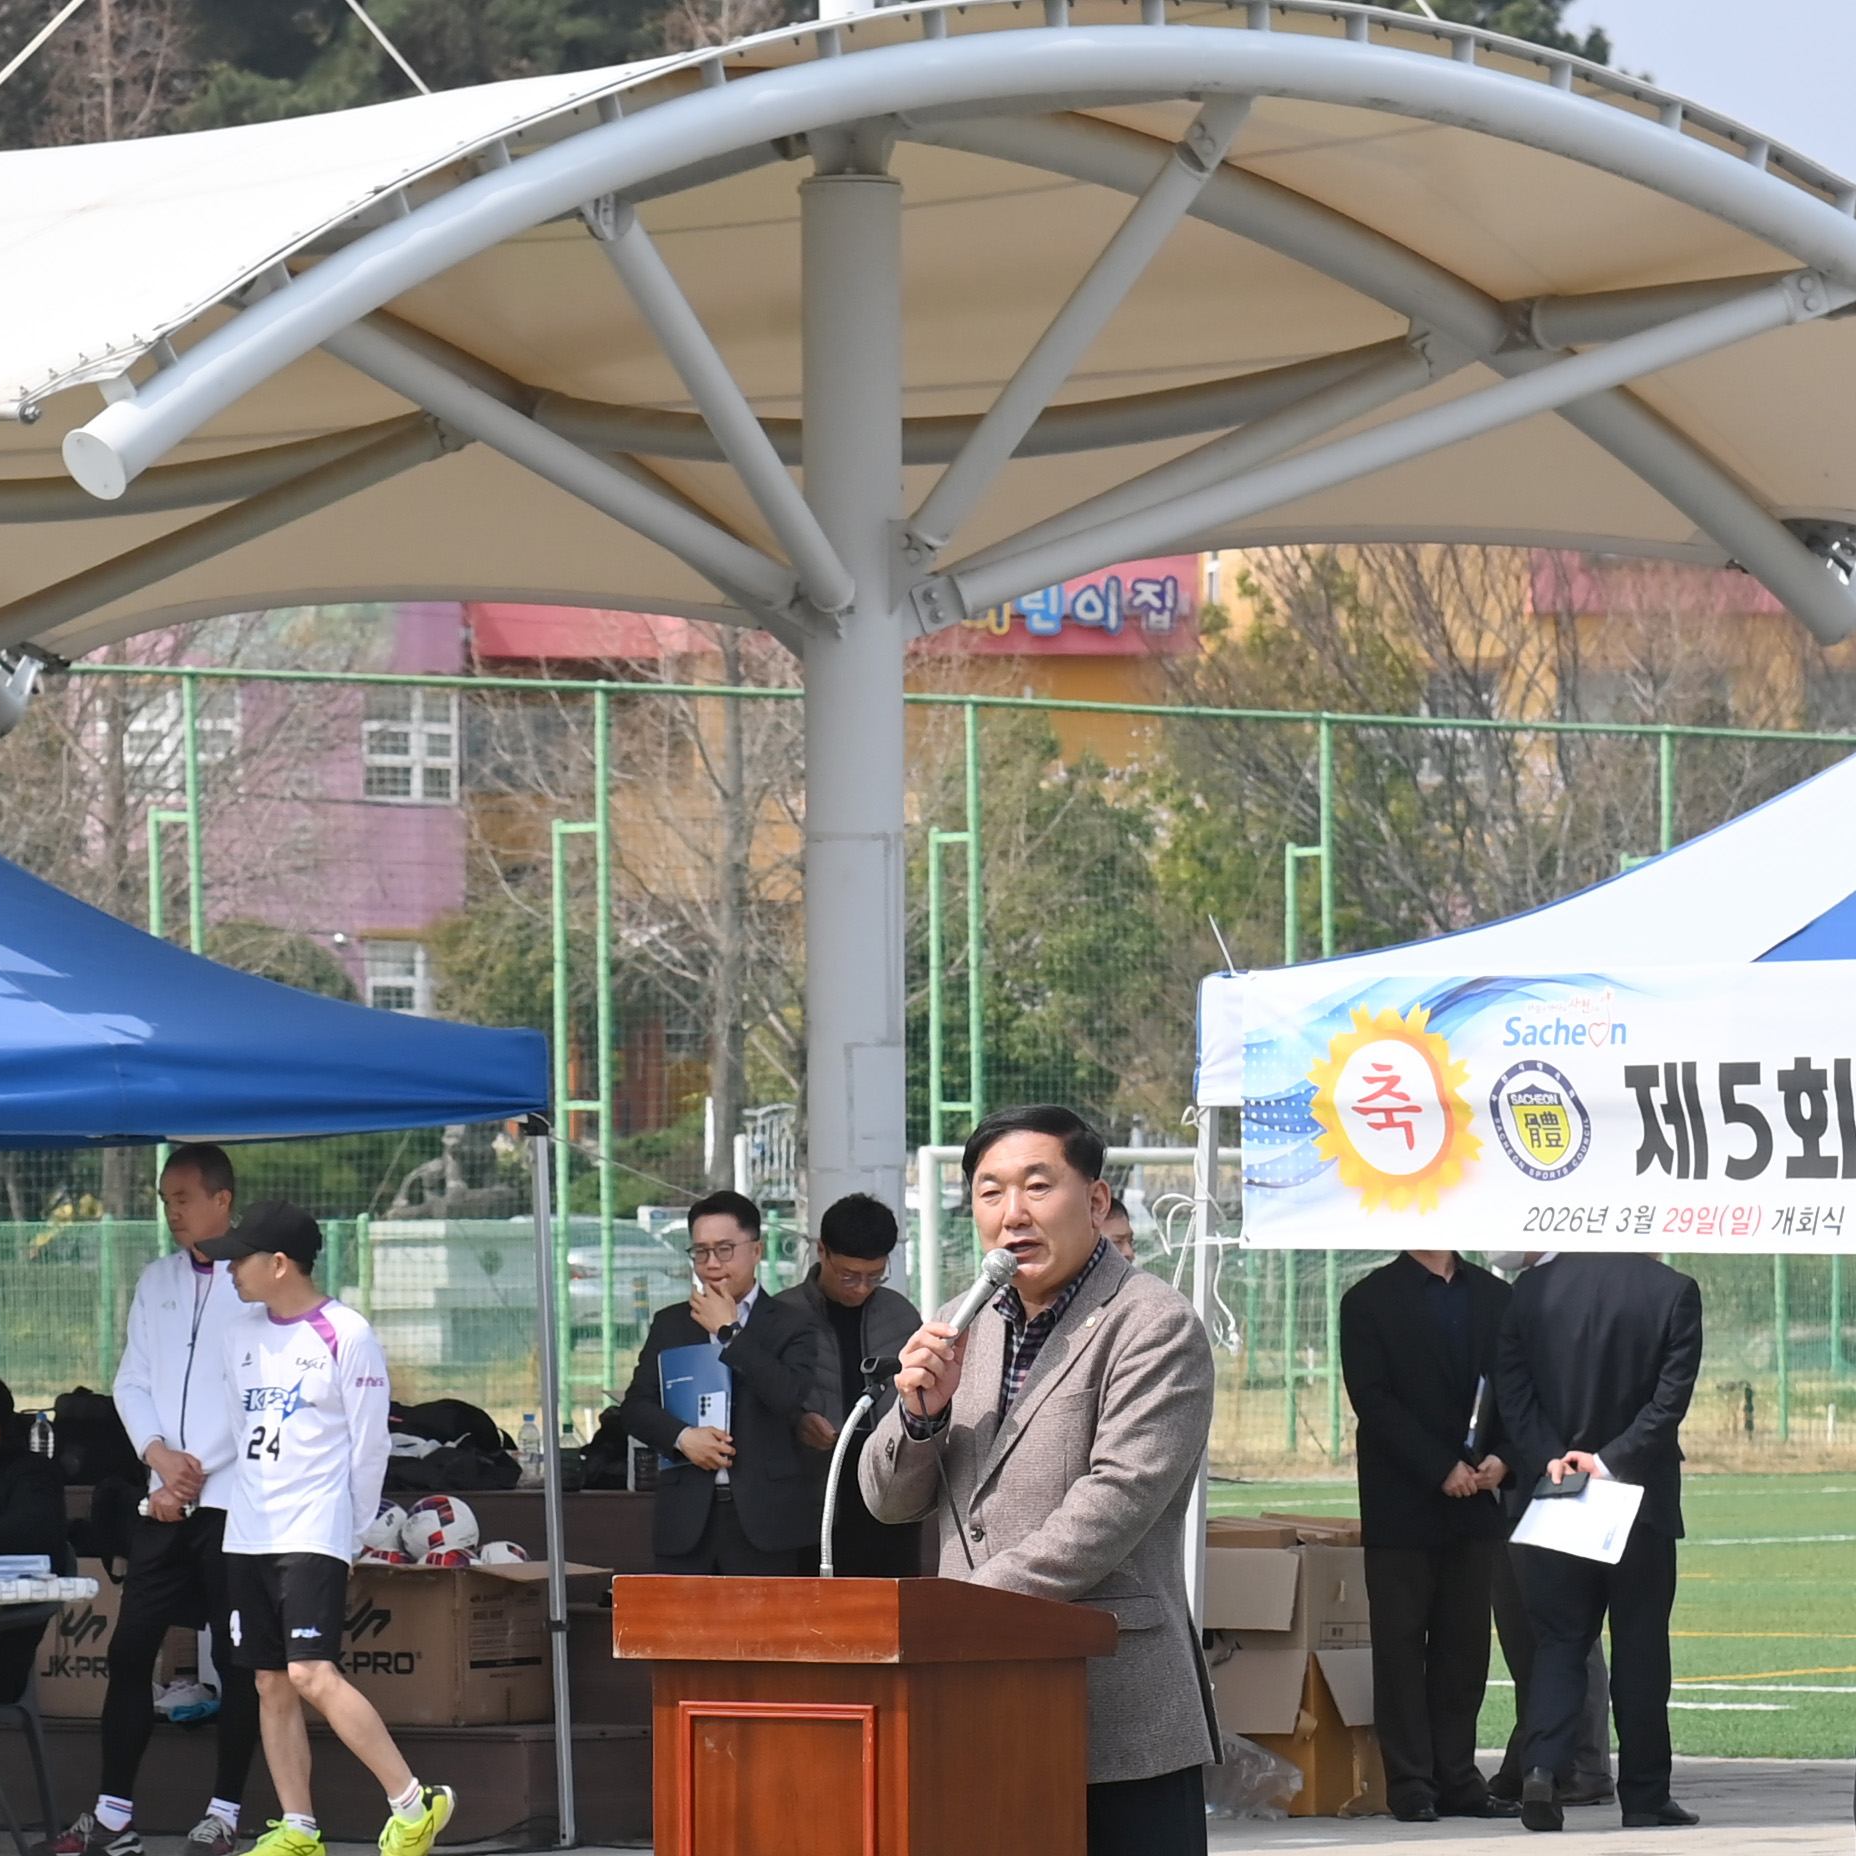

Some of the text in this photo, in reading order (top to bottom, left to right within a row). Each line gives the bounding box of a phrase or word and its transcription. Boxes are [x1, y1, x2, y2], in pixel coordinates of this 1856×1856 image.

[961, 574, 1180, 636] 린이집
[1352, 1062, 1423, 1151] 축
[1510, 1092, 1559, 1106] SACHEON
[1528, 1166, 1569, 1180] SPORTS
[1571, 1117, 1591, 1167] COUNCIL
[1523, 1205, 1610, 1234] 2026년
[1615, 1204, 1657, 1235] 3월
[1662, 1203, 1763, 1238] 29일(일)
[1772, 1205, 1846, 1237] 개회식
[246, 1425, 281, 1462] 24
